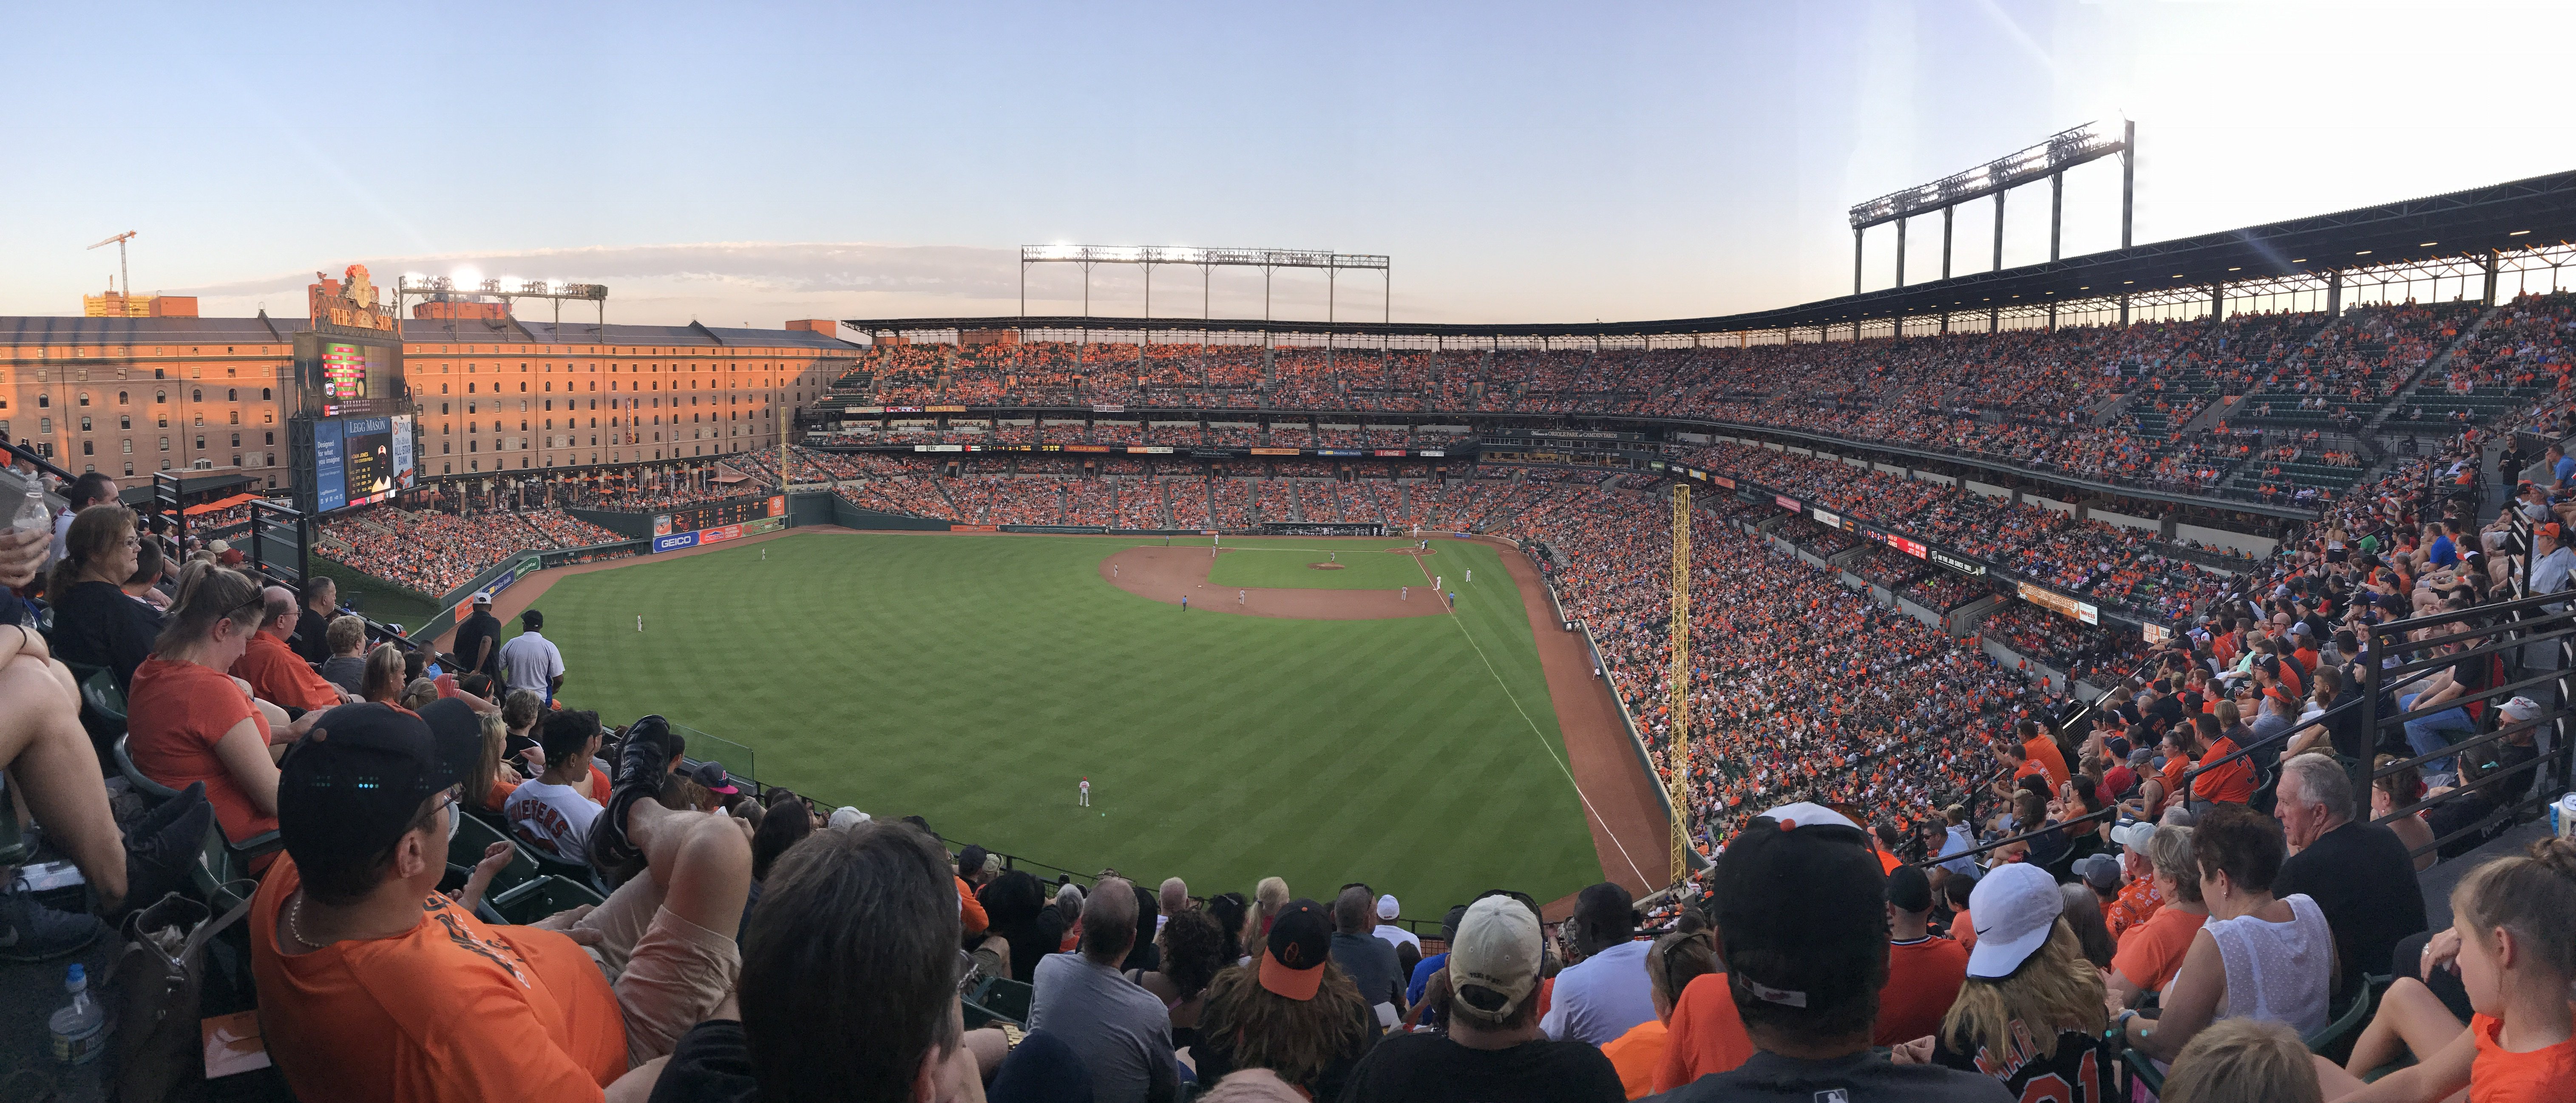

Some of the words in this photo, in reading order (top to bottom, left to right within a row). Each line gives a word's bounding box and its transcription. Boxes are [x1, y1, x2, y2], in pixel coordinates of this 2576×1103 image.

[330, 308, 352, 326] THE
[377, 315, 393, 331] SUN
[349, 422, 366, 433] LEGG
[366, 420, 386, 431] MASON
[399, 422, 411, 433] PNC
[318, 440, 334, 448] Designed
[394, 445, 411, 456] ALL-STAR
[398, 455, 408, 466] BANK
[1827, 516, 1839, 524] SHARP
[661, 536, 691, 548] GEICO
[1955, 560, 1963, 568] SINCE
[495, 582, 504, 591] MedStar
[2026, 585, 2037, 596] KIDS
[2038, 590, 2048, 601] RUN
[2049, 593, 2059, 604] THE
[2059, 596, 2075, 609] BASES
[2037, 598, 2048, 607] EVERY
[2050, 603, 2064, 613] SUNDAY
[2144, 622, 2156, 634] NEED
